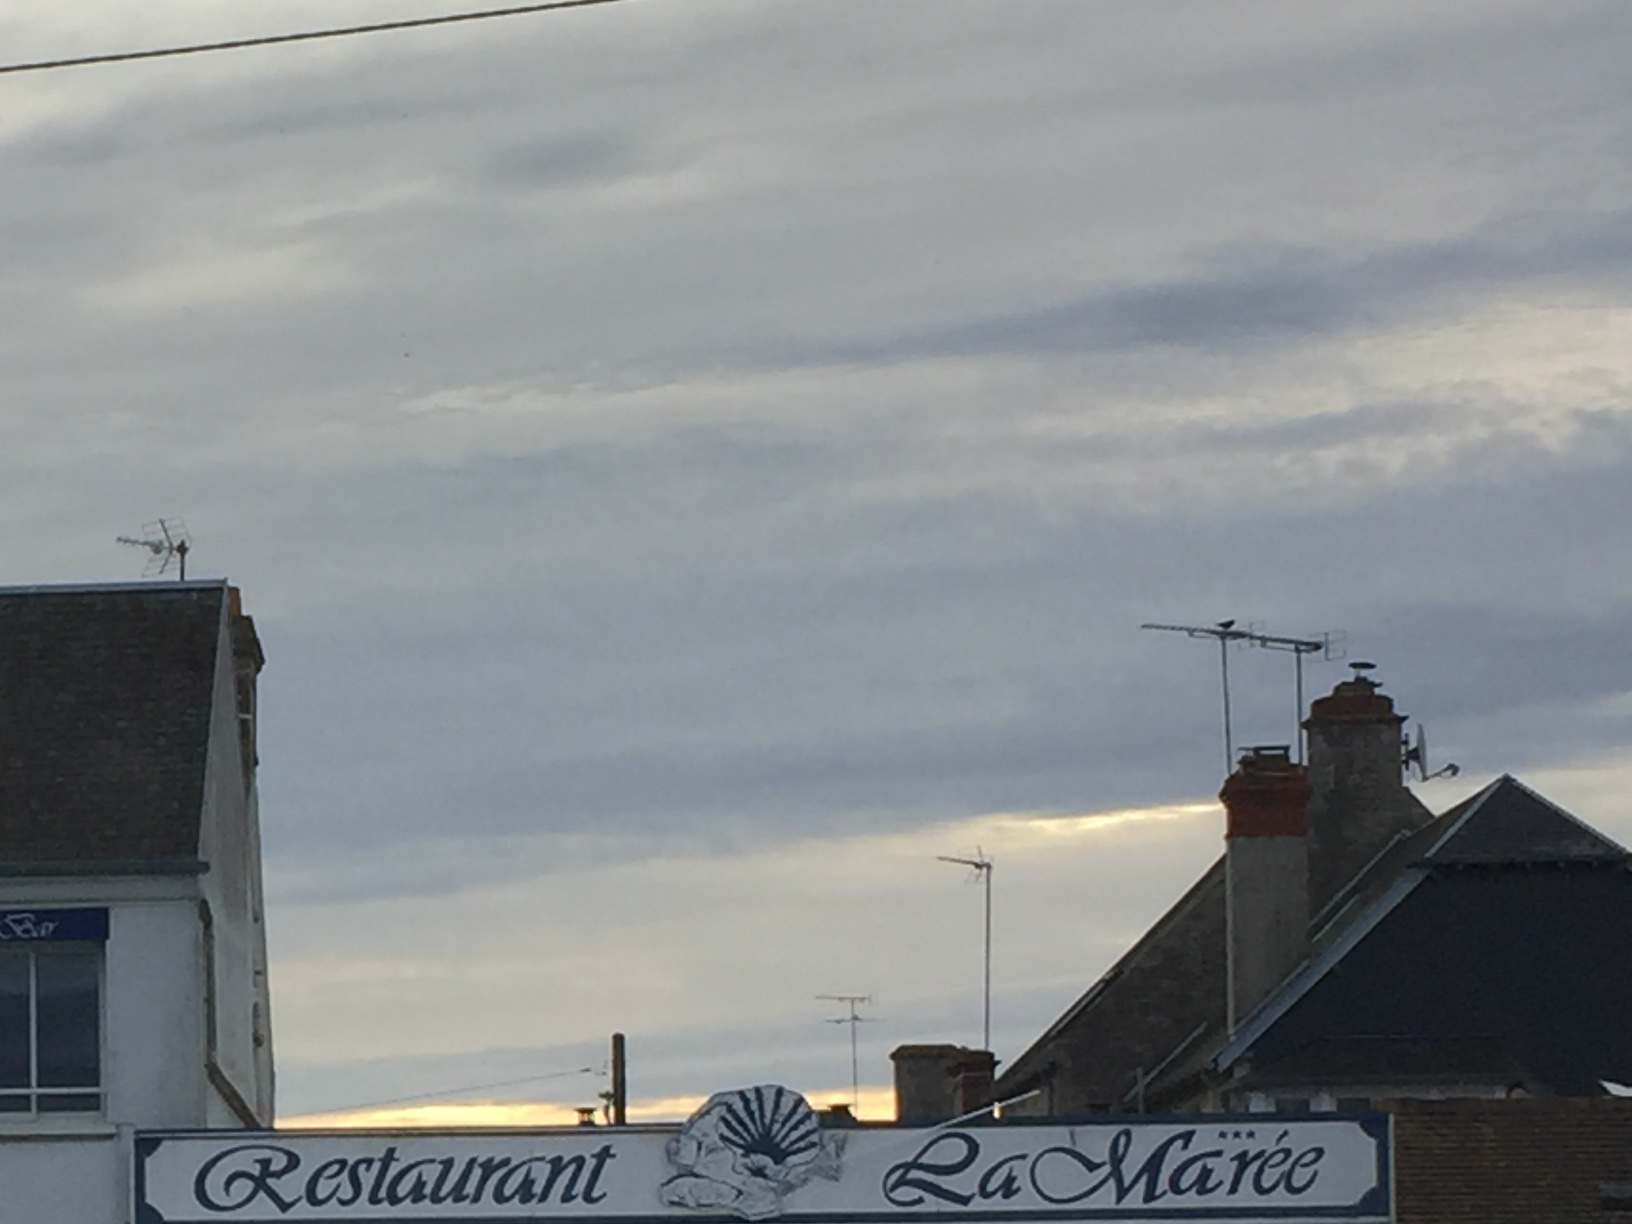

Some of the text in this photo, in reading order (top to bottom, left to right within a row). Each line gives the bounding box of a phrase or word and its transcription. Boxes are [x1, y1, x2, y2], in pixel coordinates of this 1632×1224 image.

[193, 1144, 616, 1215] Restaurant
[882, 1128, 1326, 1208] La Marée
